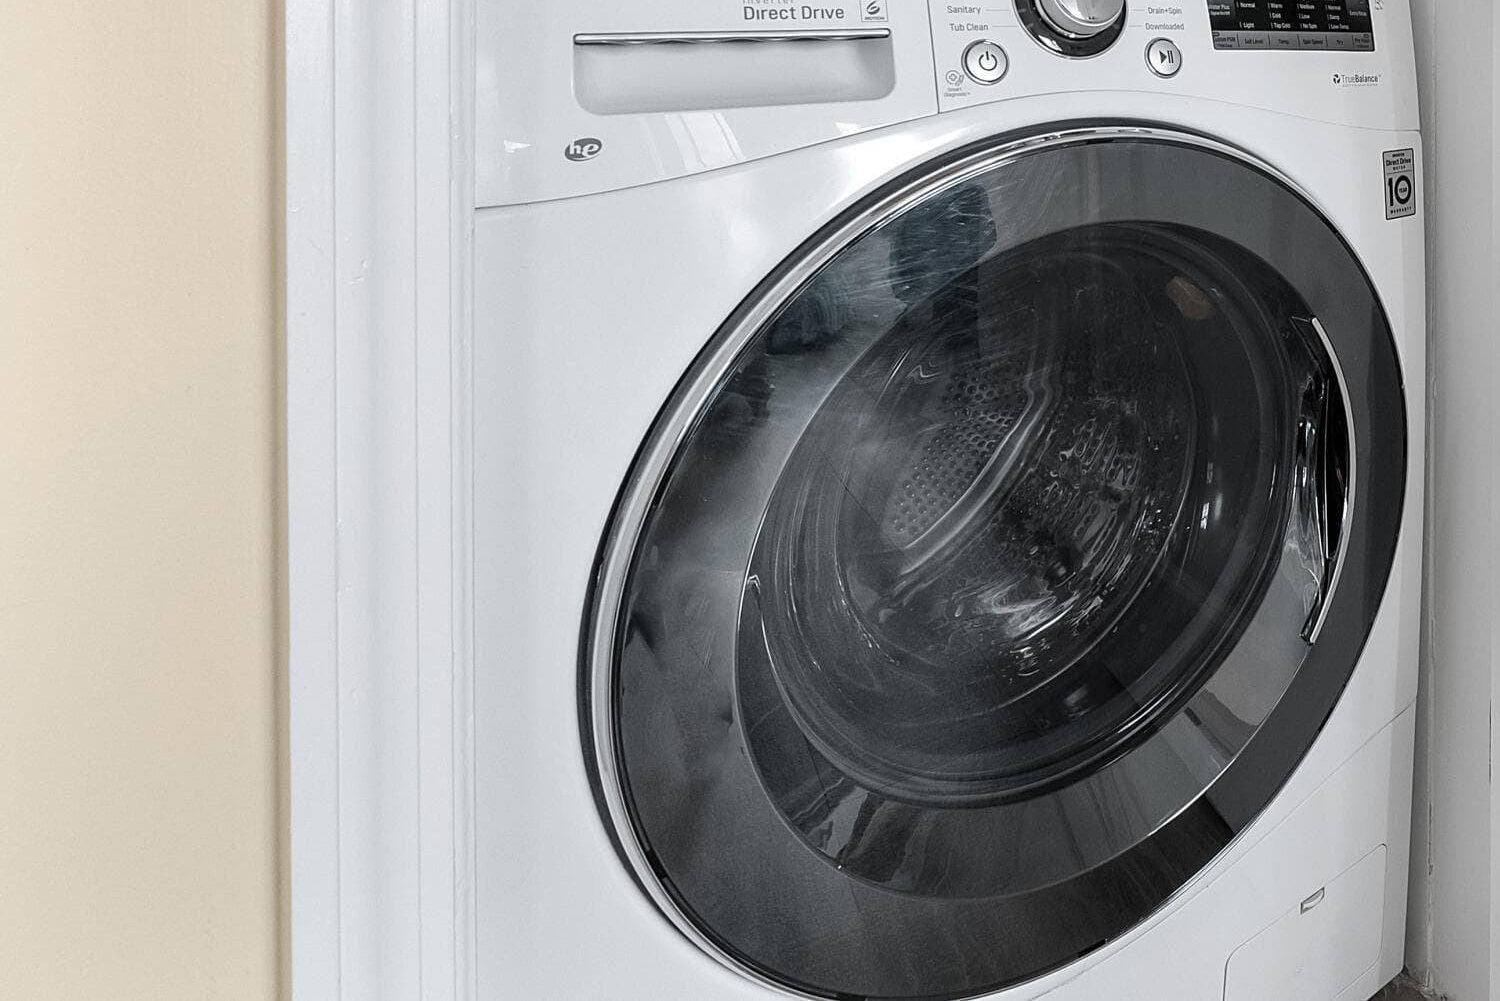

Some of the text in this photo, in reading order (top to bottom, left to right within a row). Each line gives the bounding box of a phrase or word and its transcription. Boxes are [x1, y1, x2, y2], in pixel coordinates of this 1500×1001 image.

[744, 5, 845, 20] Direct Drive
[947, 6, 981, 15] Sanitary
[1147, 7, 1182, 15] Drain+Spin
[949, 23, 989, 31] Tub Clean
[1145, 22, 1185, 30] Downloaded
[1341, 73, 1379, 83] TrueBalance
[1388, 175, 1411, 206] 10
